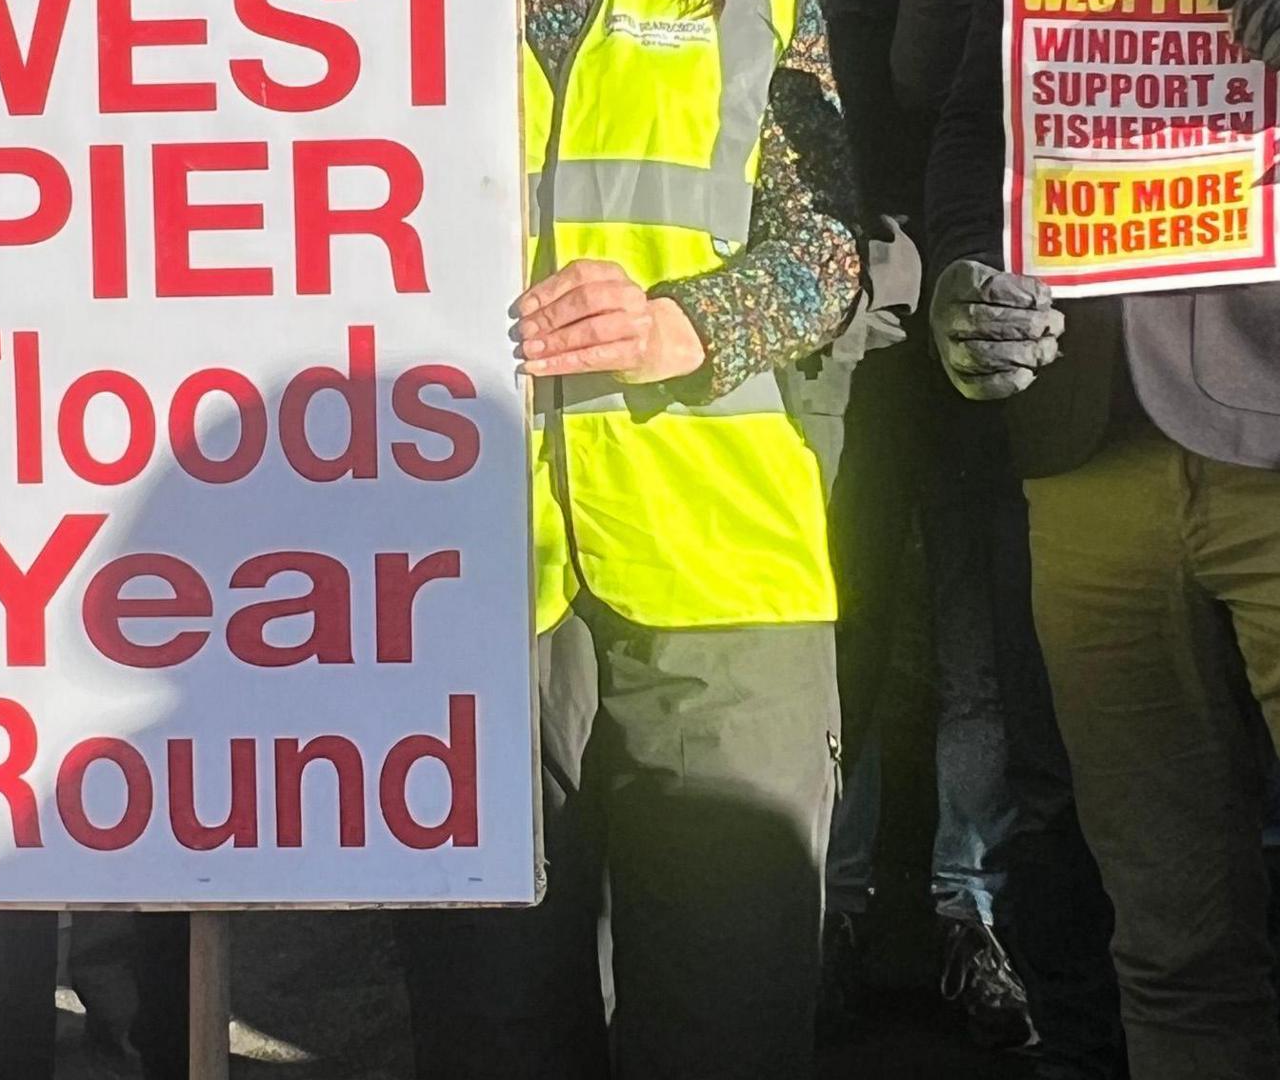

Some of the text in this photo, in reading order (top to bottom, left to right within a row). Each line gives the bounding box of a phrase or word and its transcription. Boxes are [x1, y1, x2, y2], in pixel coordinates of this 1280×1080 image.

[1033, 72, 1254, 108] SUPPORT &
[1034, 111, 1254, 150] FISHERMEN
[1045, 170, 1243, 217] NOT MORE
[1038, 207, 1248, 258] BURGERS!!
